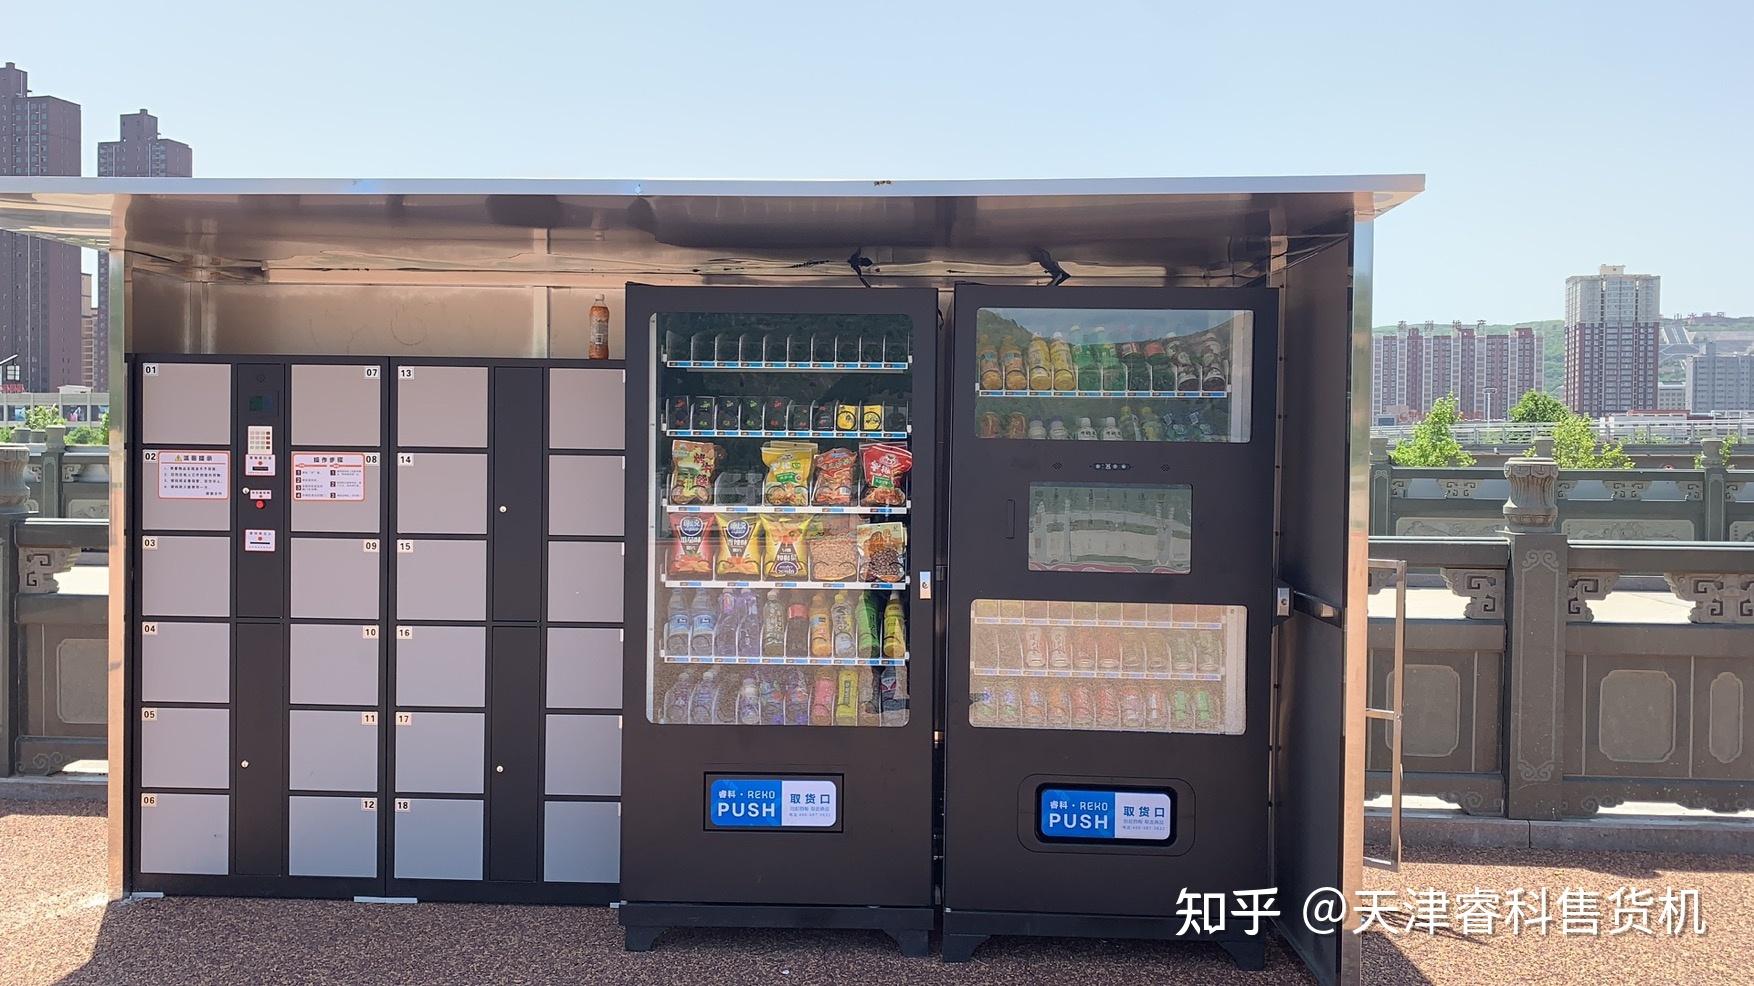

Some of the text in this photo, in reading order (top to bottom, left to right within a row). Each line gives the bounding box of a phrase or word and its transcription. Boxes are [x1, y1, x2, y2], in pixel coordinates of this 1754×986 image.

[145, 365, 156, 374] 01
[366, 368, 378, 377] 07
[400, 369, 412, 378] 13
[144, 452, 156, 461] 02
[365, 455, 378, 464] 08
[400, 456, 411, 464] 14
[144, 538, 156, 547] 03
[365, 541, 377, 550] 09
[400, 542, 411, 551] 15
[144, 624, 156, 633] 04
[365, 628, 376, 636] 10
[399, 629, 410, 637] 16
[143, 710, 155, 719] 05
[365, 714, 375, 723] 11
[399, 715, 409, 723] 17
[718, 790, 775, 799] 睿科 REKO
[790, 793, 830, 805] 取货口
[143, 796, 155, 805] 06
[364, 800, 375, 809] 12
[397, 801, 409, 810] 18
[717, 802, 775, 817] PUSH
[1050, 800, 1108, 812] 睿科 REKO
[1123, 806, 1165, 818] 取货口
[1049, 813, 1108, 829] PUSH
